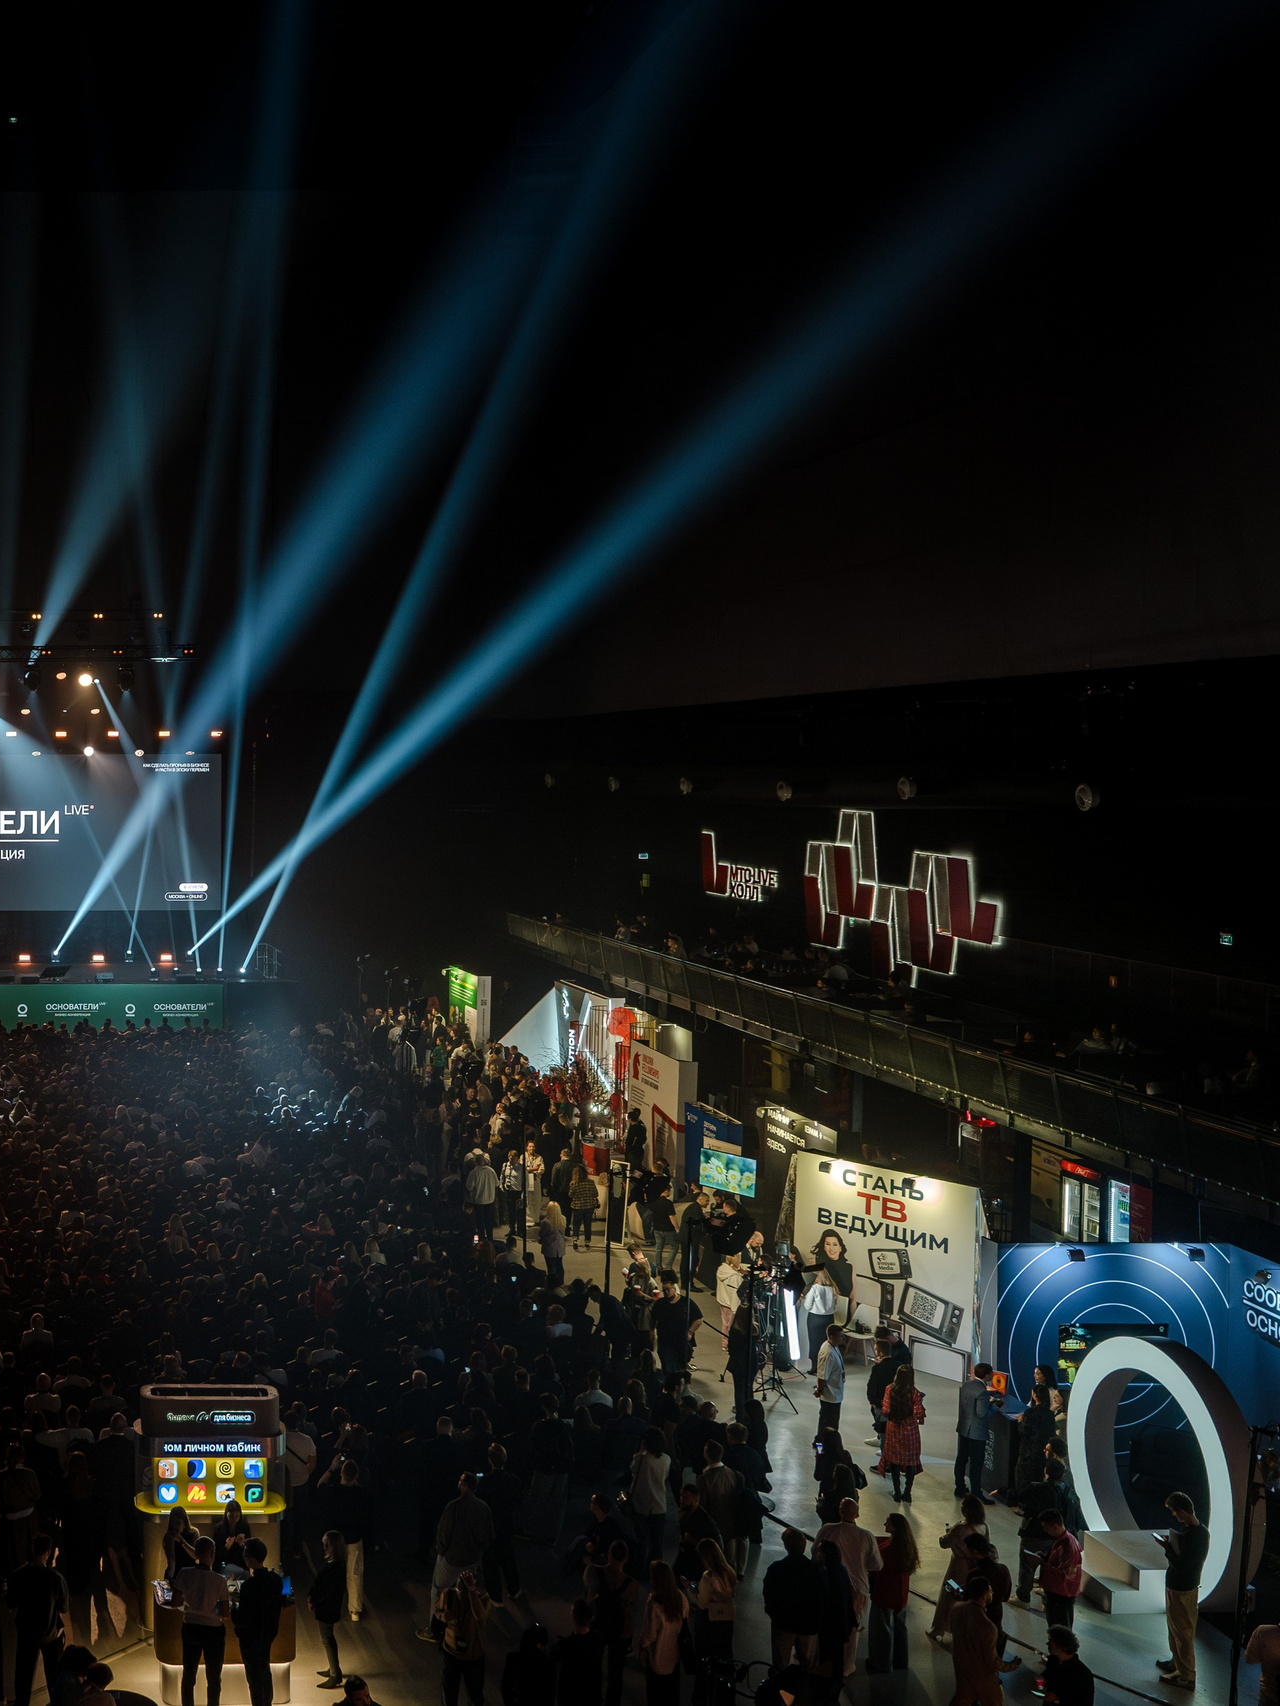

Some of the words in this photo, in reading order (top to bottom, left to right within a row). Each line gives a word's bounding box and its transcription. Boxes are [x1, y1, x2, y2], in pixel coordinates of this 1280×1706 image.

[64, 804, 89, 816] LIVE
[766, 1122, 806, 1149] НАЧИНАЕТСЯ
[766, 1137, 787, 1154] ЗДЕСЬ
[843, 1168, 924, 1202] СТАНЬ
[857, 1191, 907, 1223] ТВ
[817, 1207, 949, 1254] ВЕДУЩИМ
[1246, 1309, 1280, 1341] ОСН
[225, 1412, 252, 1422] бизнеса
[183, 1443, 224, 1453] личном
